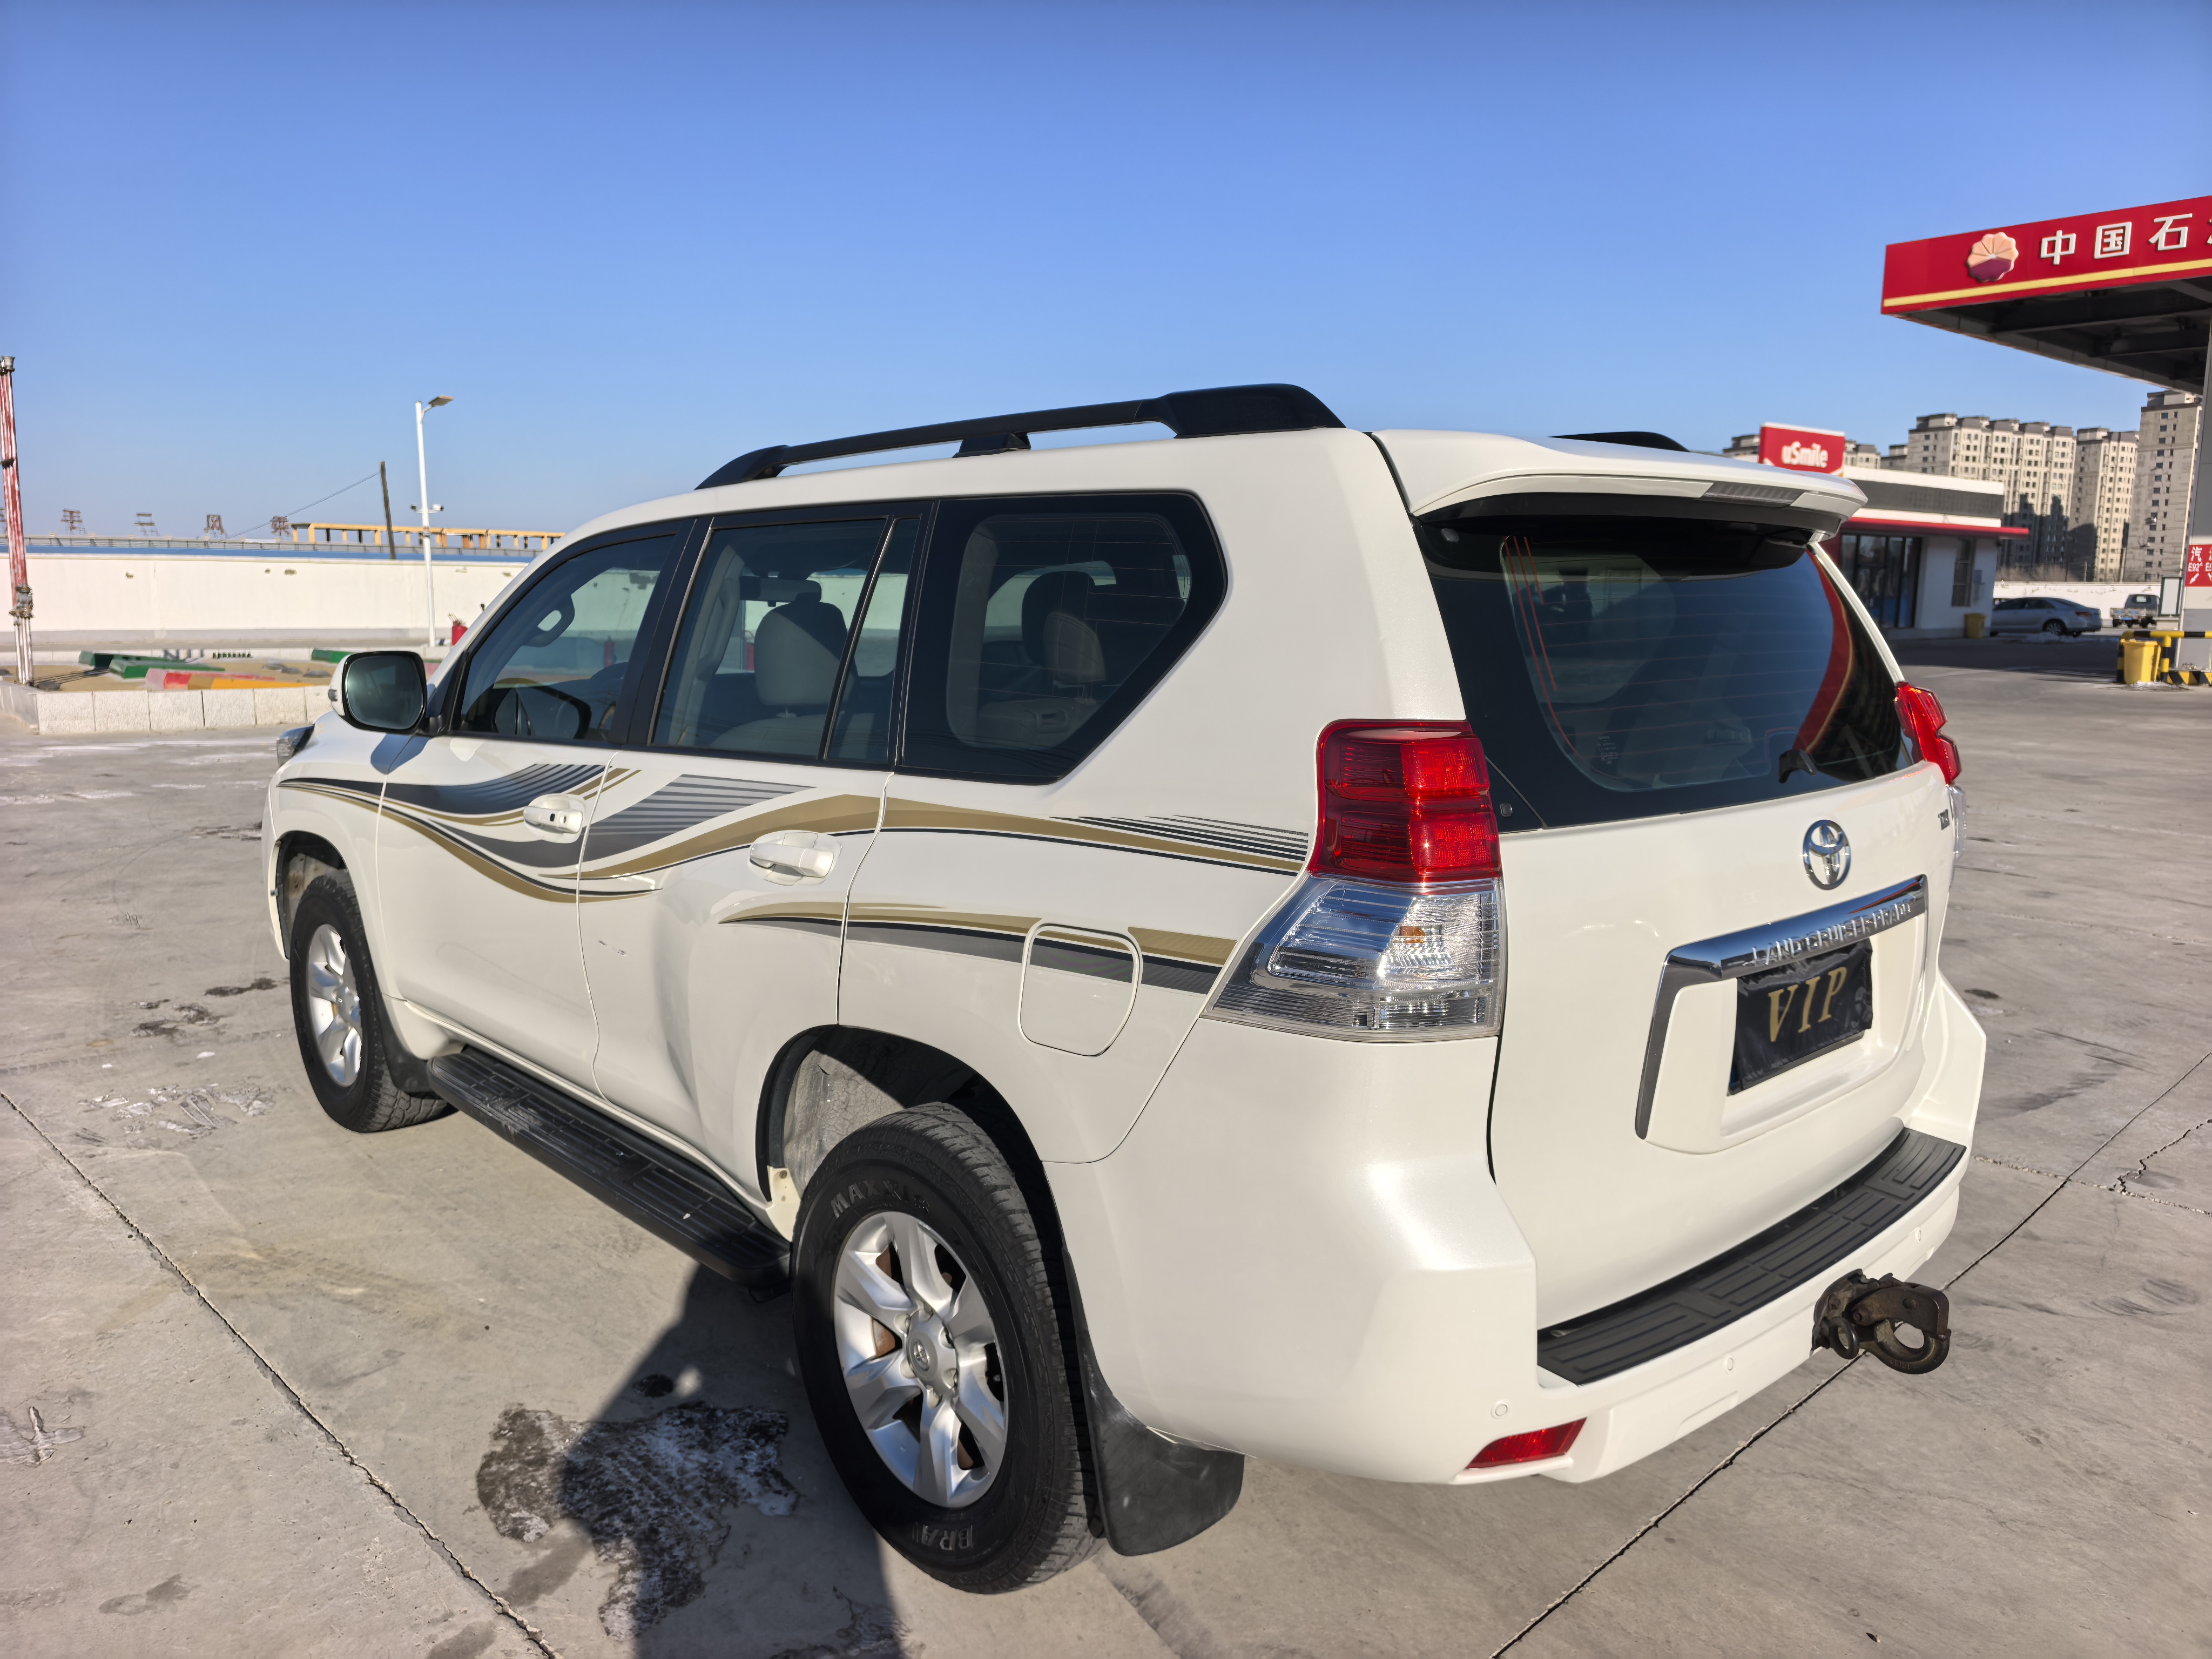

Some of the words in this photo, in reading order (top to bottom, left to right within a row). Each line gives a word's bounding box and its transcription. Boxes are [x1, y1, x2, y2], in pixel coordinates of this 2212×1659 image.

[2040, 213, 2212, 266] 中国石
[1781, 441, 1828, 468] uSmile
[1752, 935, 1802, 967] LAND
[1805, 914, 1871, 952] CRUISER
[1768, 966, 1847, 1043] VIP
[830, 1179, 930, 1219] MAXXIS
